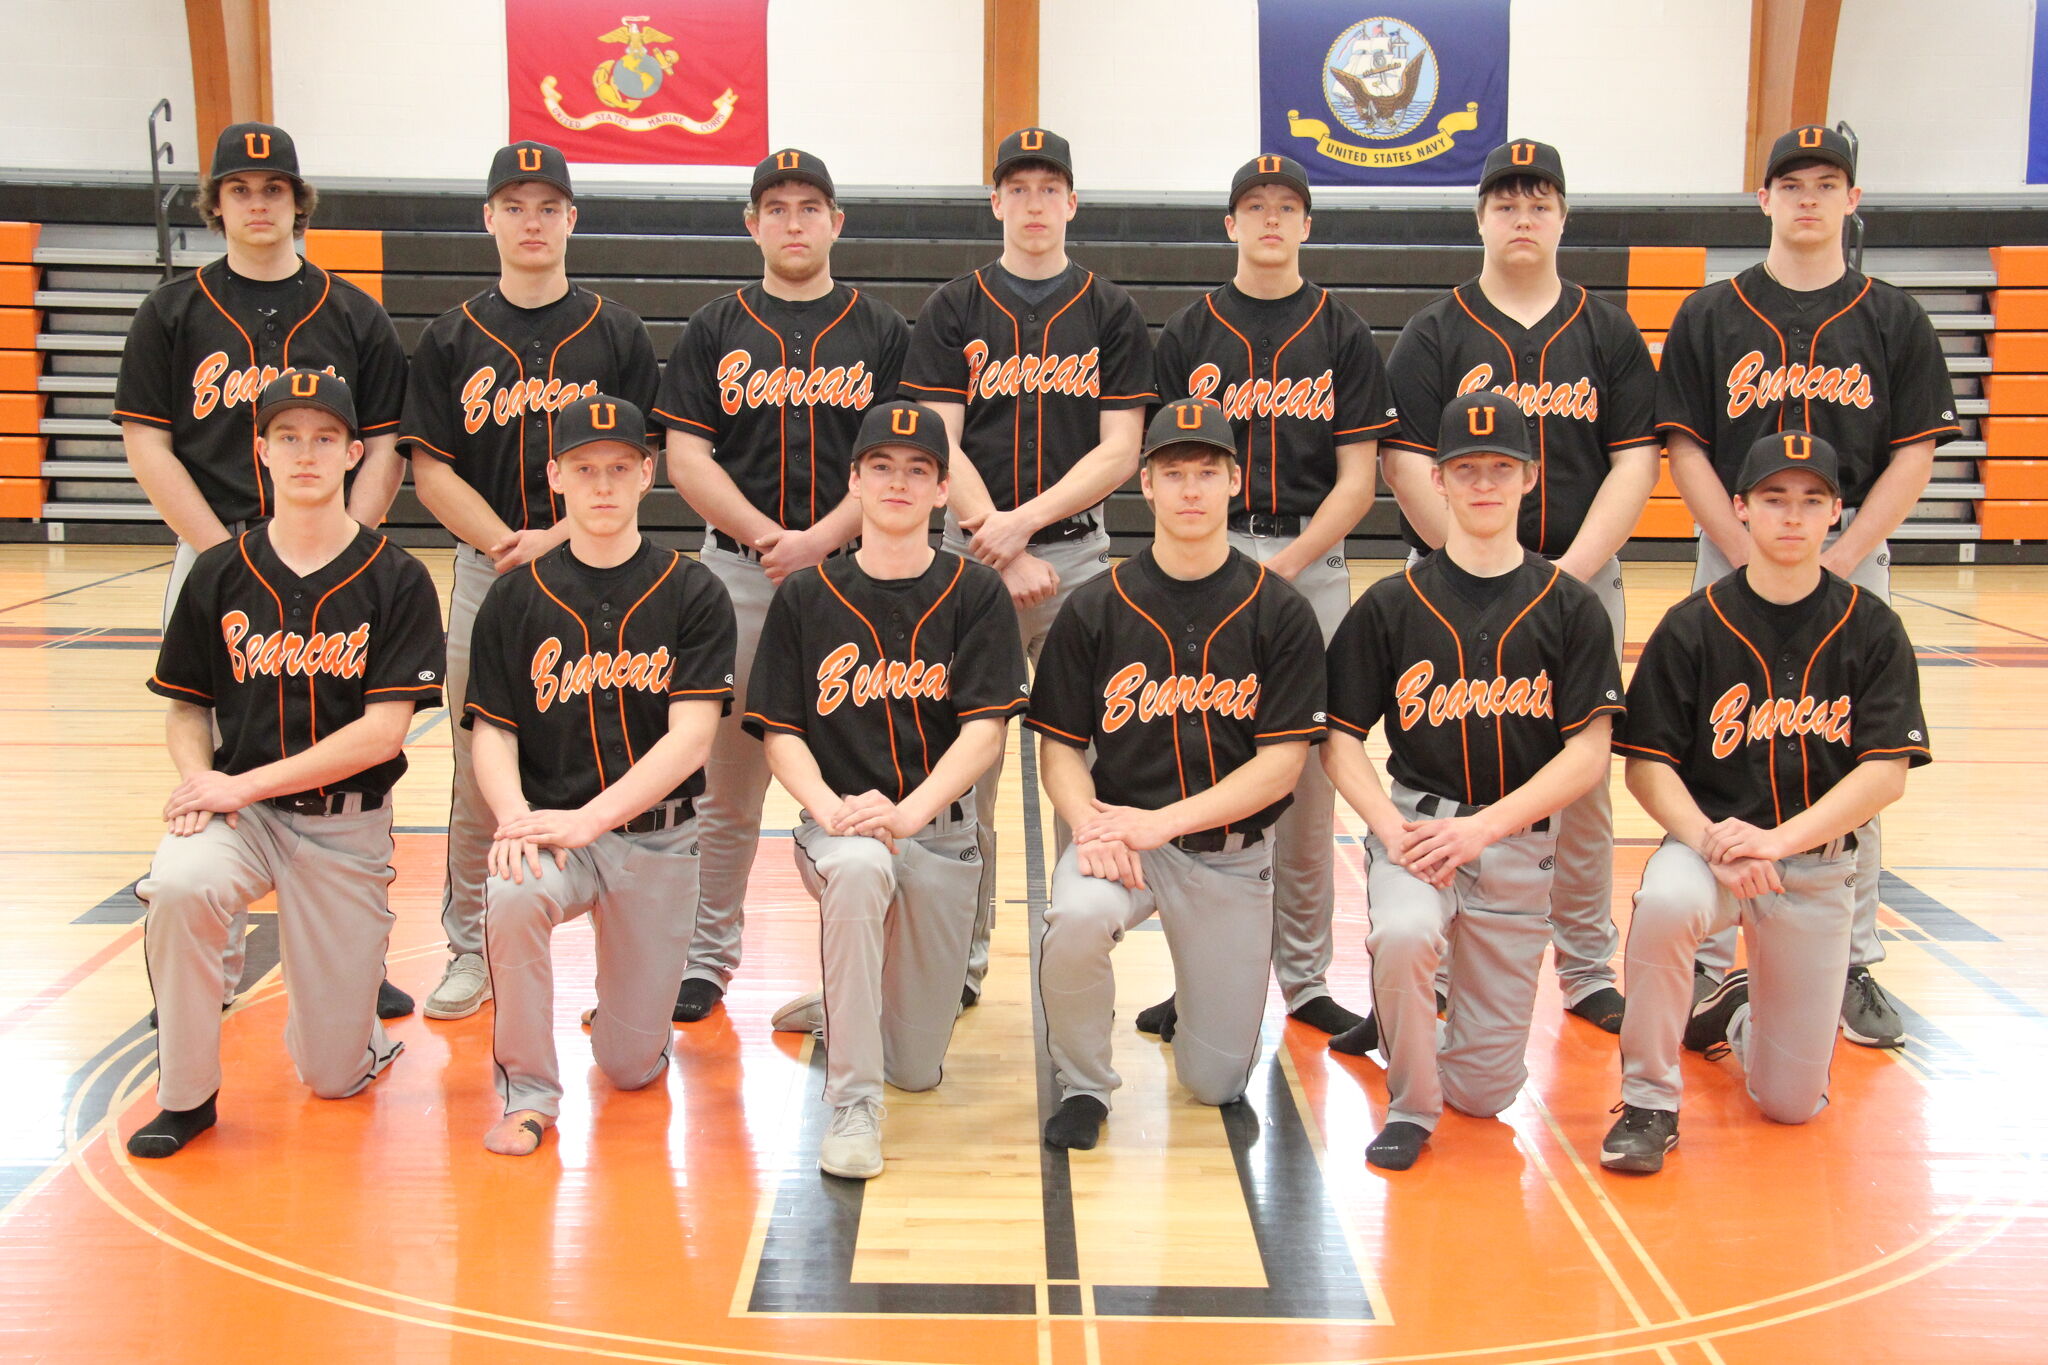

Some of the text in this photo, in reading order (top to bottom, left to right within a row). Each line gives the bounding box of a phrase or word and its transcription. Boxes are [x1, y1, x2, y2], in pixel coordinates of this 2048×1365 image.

[552, 106, 725, 131] UNITED STATES MARINE CORPS
[245, 133, 271, 159] U
[1020, 131, 1045, 151] U
[1798, 128, 1824, 148] U
[517, 148, 542, 172] U
[776, 152, 800, 170] U
[1326, 139, 1446, 164] UNITED STATES NAVY
[1511, 144, 1536, 166] U
[1257, 156, 1282, 174] U
[192, 351, 346, 420] Bear
[291, 373, 320, 398] U
[717, 349, 874, 416] Bearcats
[1457, 363, 1598, 422] Barcats
[1726, 350, 1873, 418] Bearcats
[460, 366, 603, 434] Bearca
[589, 403, 617, 430] U
[892, 409, 919, 436] U
[1176, 404, 1203, 430] U
[1468, 407, 1496, 436] U
[1784, 435, 1812, 460] U
[816, 642, 954, 717] Bearca
